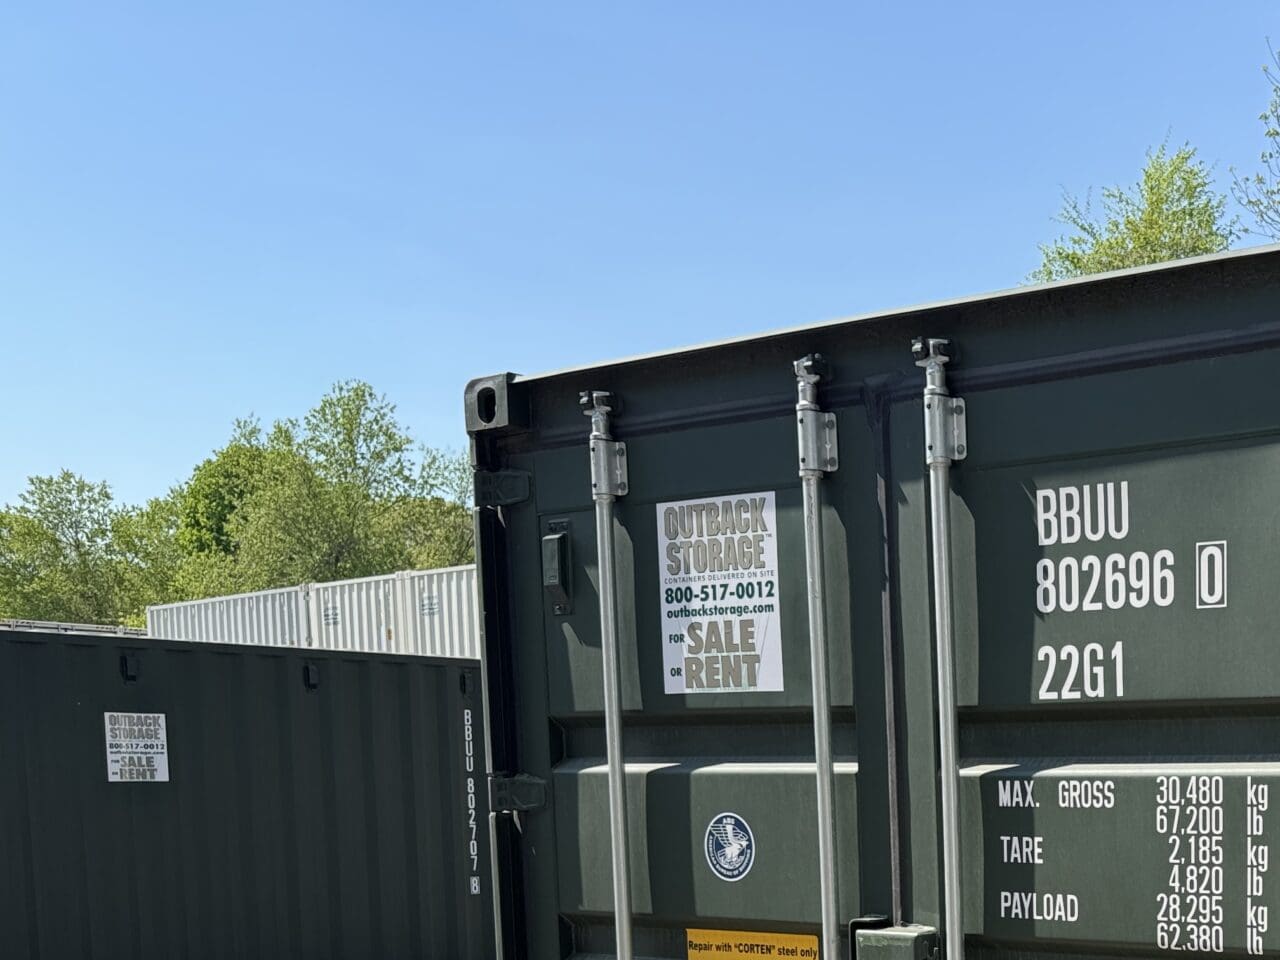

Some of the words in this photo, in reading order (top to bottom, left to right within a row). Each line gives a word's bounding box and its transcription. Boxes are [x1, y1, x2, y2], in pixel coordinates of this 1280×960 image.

[664, 497, 767, 540] OUTBACK
[1036, 480, 1130, 546] BBUU
[666, 533, 766, 576] STORAGE
[664, 575, 706, 585] CONTAINERS
[707, 572, 745, 581] DELIVERED
[664, 580, 775, 604] 800-517-0012
[1036, 549, 1175, 613] 802696
[666, 603, 775, 619] outbackstorage.com
[669, 634, 685, 643] FOR
[686, 619, 756, 654] SALE
[670, 667, 682, 677] OR
[684, 654, 760, 689] RENT
[1037, 641, 1124, 700] 22G1
[108, 714, 161, 728] OUTBACK
[110, 727, 161, 740] STORAGE
[464, 709, 474, 772] BBUU
[120, 756, 155, 768] SALE
[120, 768, 158, 780] RENT
[998, 780, 1040, 808] MAX.
[1058, 781, 1115, 808] GROSS
[1156, 776, 1223, 806] 30,480
[1247, 776, 1269, 811] kg
[467, 778, 478, 871] 802707
[1156, 805, 1223, 835] 67,200
[1247, 806, 1263, 836] lb
[1000, 836, 1044, 864] TARE
[1168, 836, 1223, 865] 2,185
[1247, 837, 1269, 872] kg
[1168, 864, 1223, 894] 4,820
[1247, 867, 1263, 896] lb
[1000, 892, 1079, 922] PAYLOAD
[1156, 893, 1223, 924] 28,295
[1247, 897, 1269, 932] kg
[688, 940, 714, 953] Repair
[715, 942, 733, 953] with
[777, 945, 799, 957] steel
[800, 947, 818, 960] only
[1156, 922, 1223, 953] 62,380
[1247, 927, 1264, 955] lb
